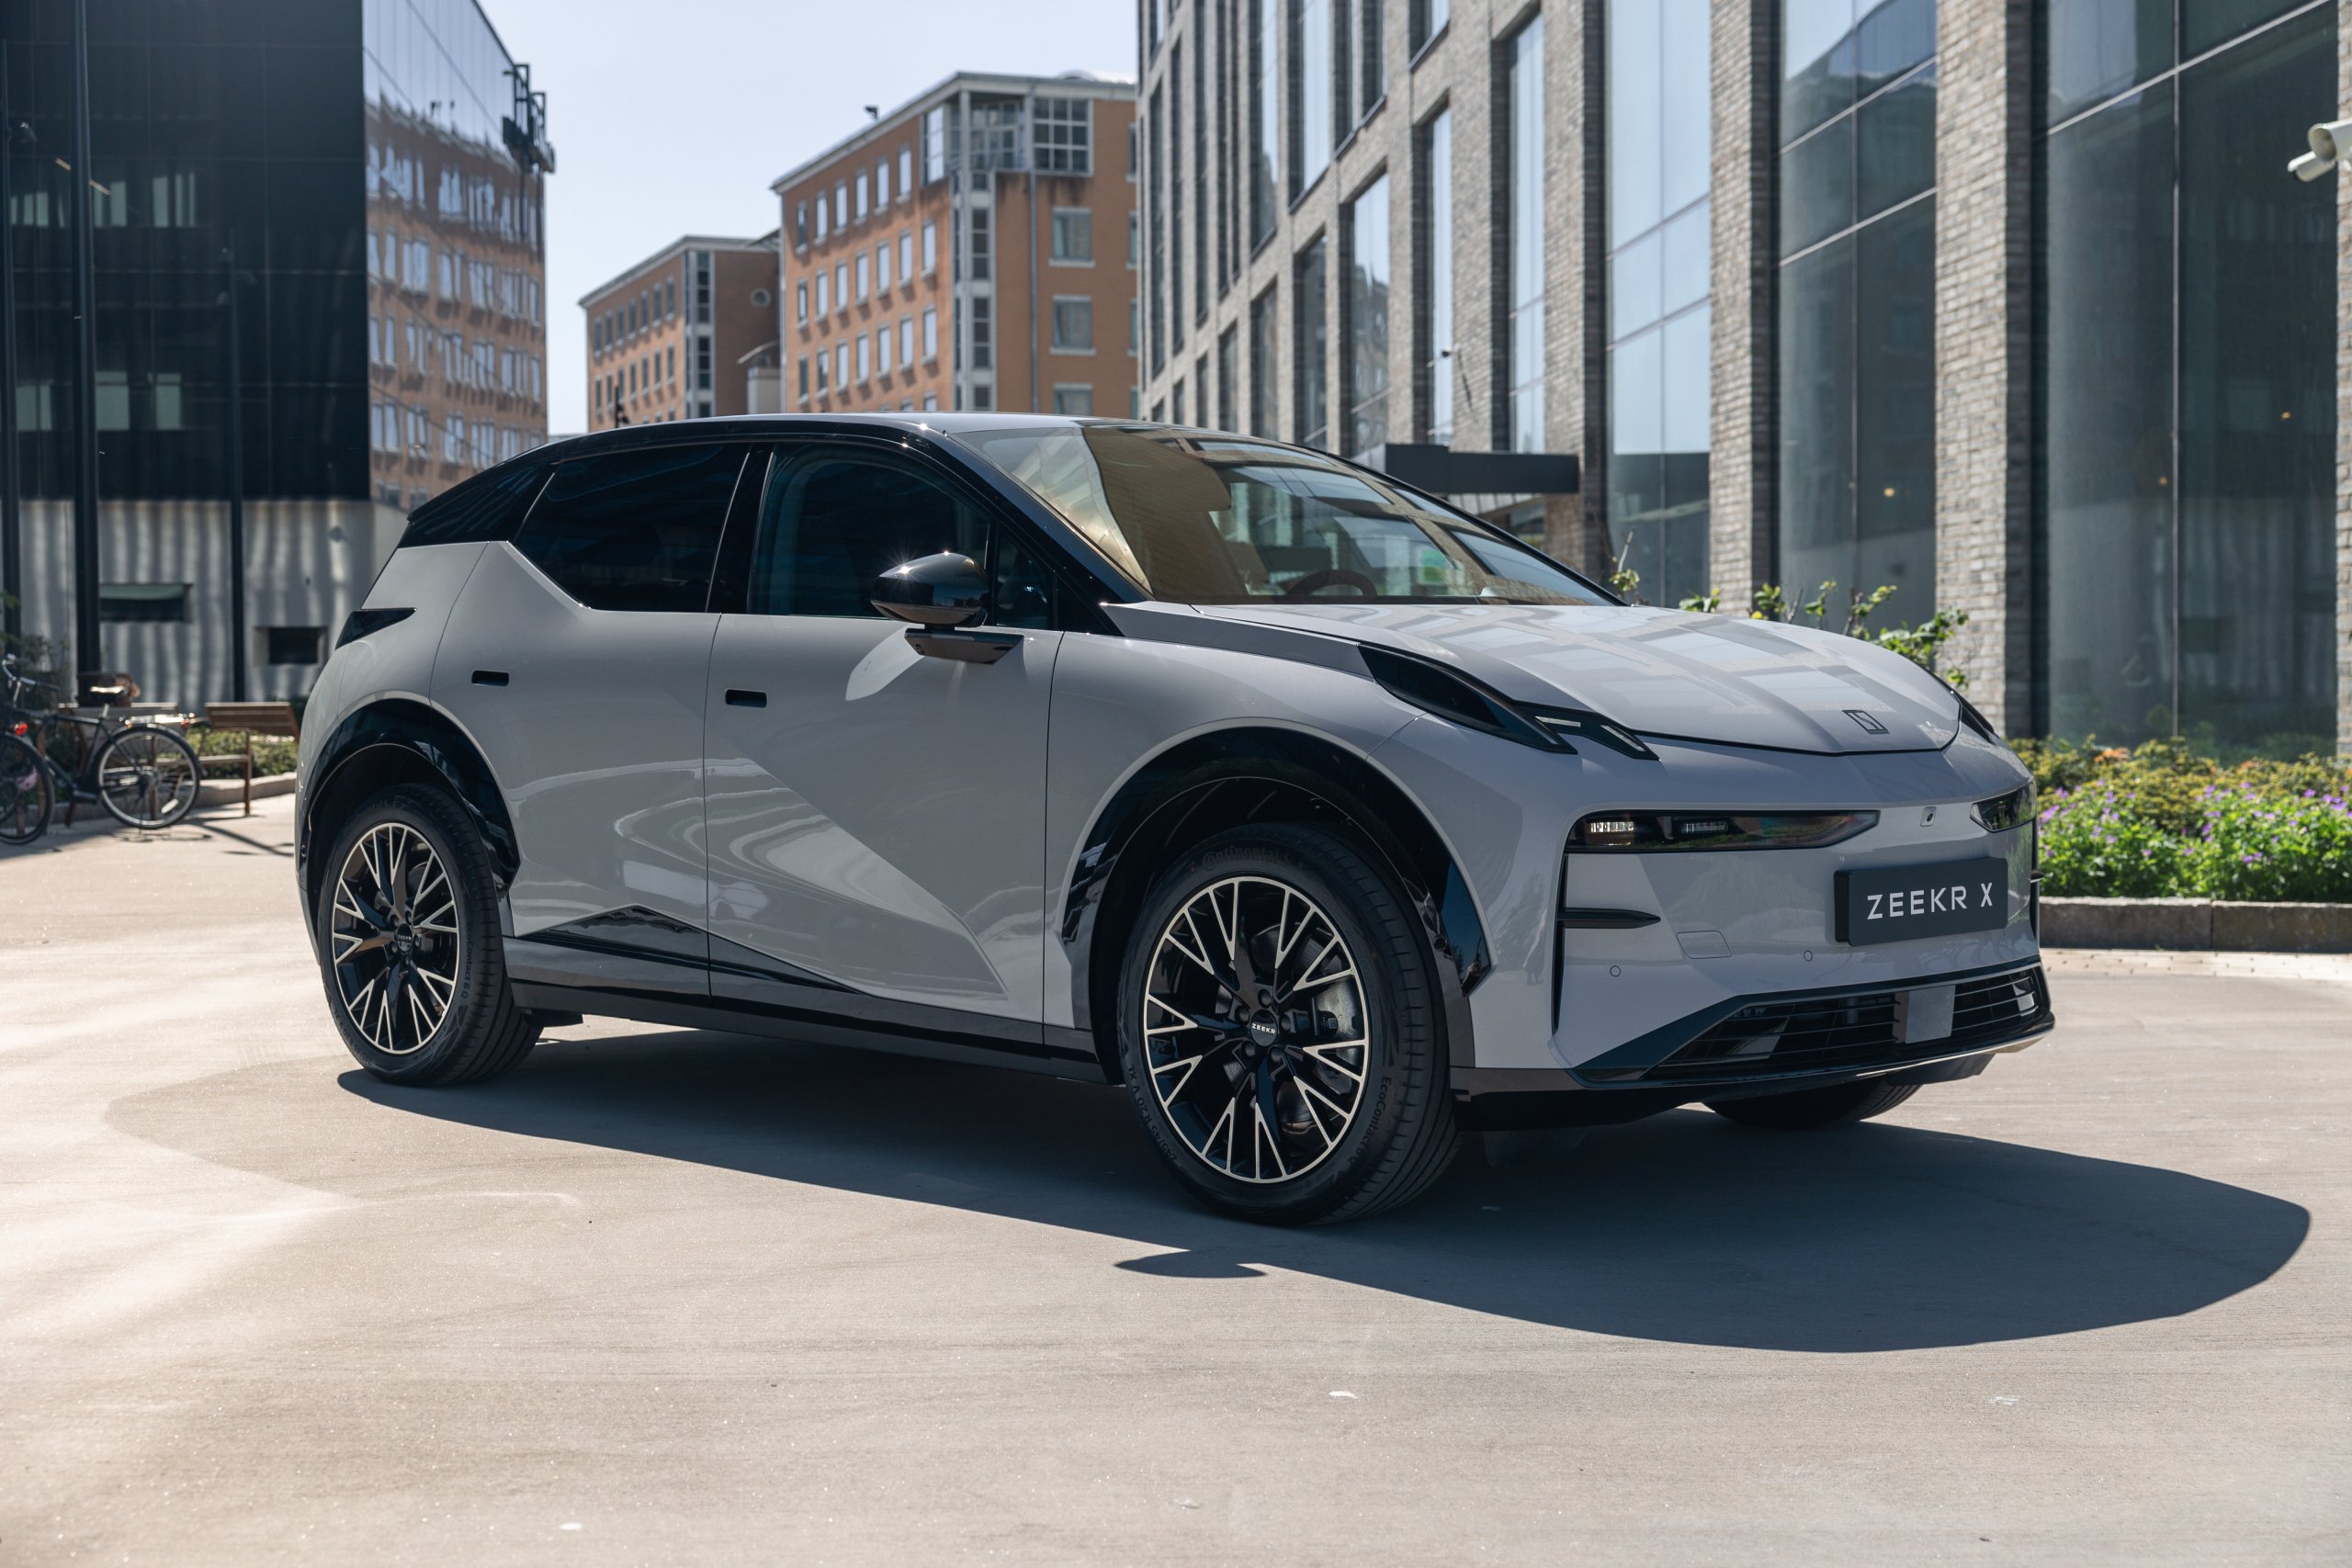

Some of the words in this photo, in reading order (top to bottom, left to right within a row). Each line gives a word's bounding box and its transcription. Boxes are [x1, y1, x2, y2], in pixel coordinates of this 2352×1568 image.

[1867, 886, 1968, 920] ZEEKR
[1980, 882, 1993, 908] X
[1251, 1022, 1276, 1034] ZEEKR
[1360, 1076, 1393, 1148] EcoContact
